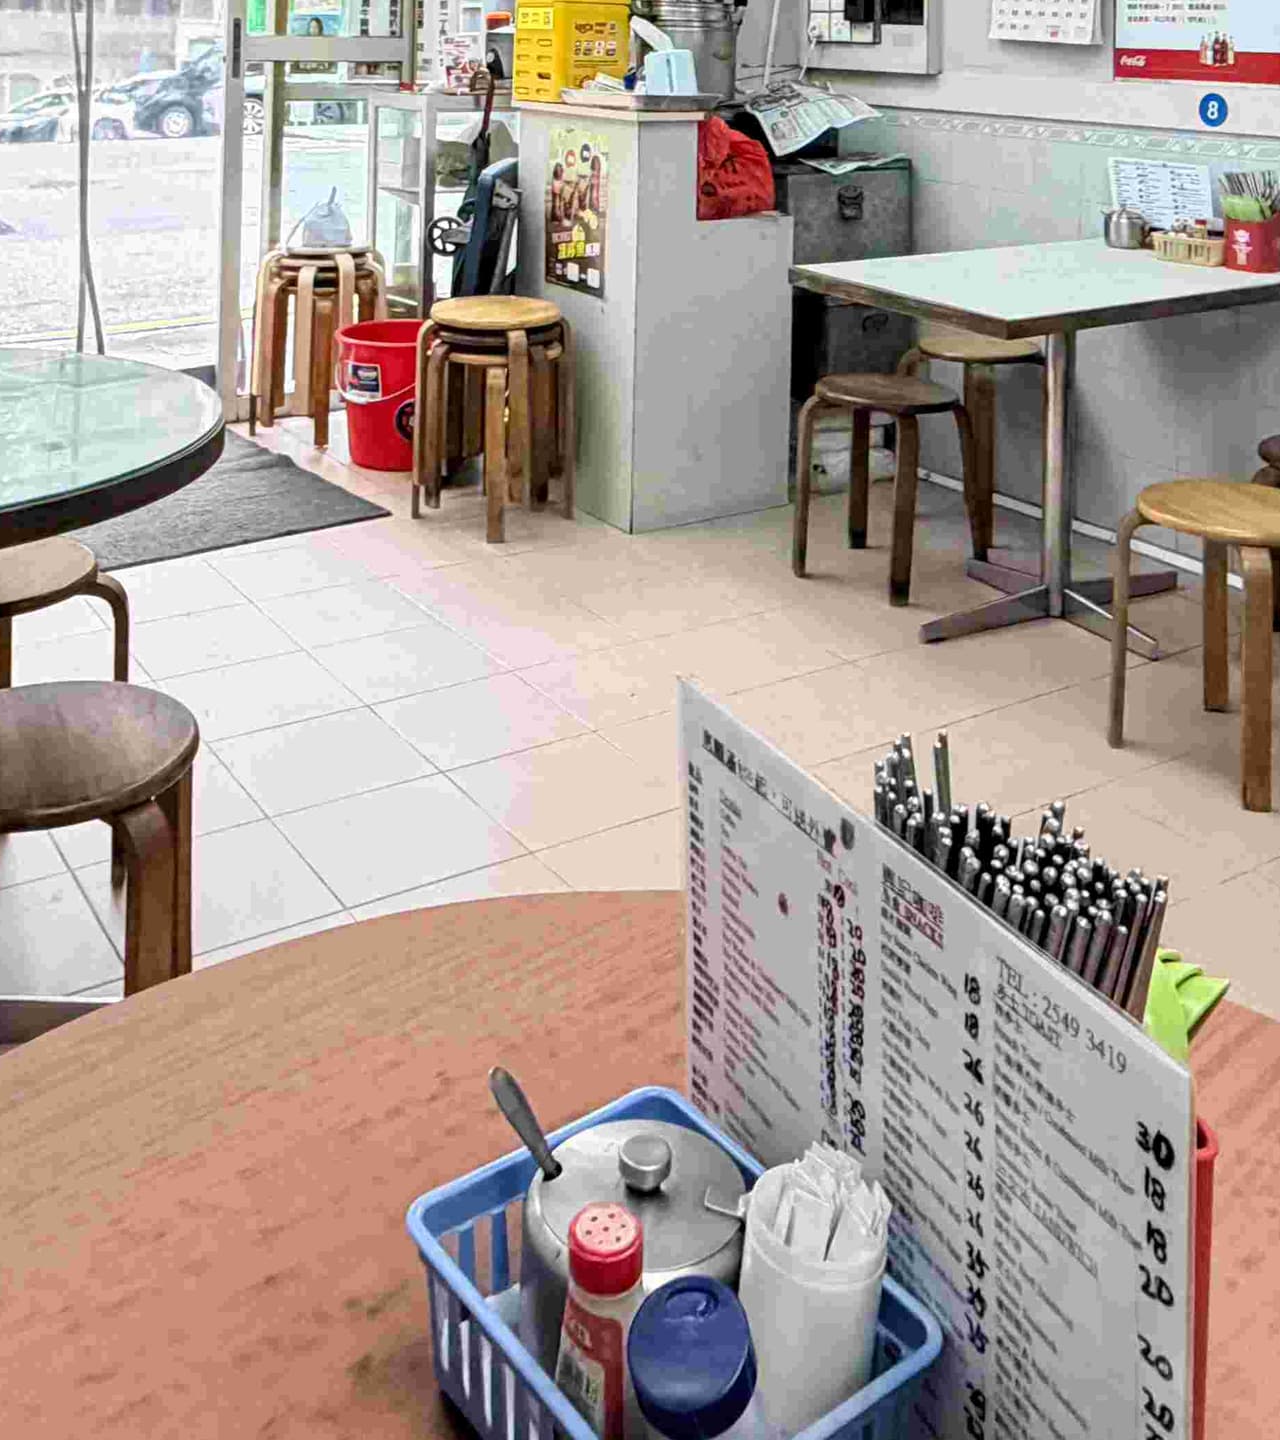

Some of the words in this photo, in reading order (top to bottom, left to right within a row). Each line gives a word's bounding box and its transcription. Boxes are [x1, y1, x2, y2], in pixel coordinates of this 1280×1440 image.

[1207, 100, 1219, 120] 8
[963, 971, 982, 1007] 18
[1042, 994, 1080, 1039] 2549
[1085, 1029, 1127, 1075] 3419
[963, 1092, 985, 1127] 26
[1136, 1120, 1175, 1172] 30
[966, 1169, 985, 1203] 26
[1143, 1166, 1167, 1212] 18
[1146, 1220, 1168, 1263] 18
[1137, 1265, 1175, 1309] 20
[1136, 1333, 1173, 1383] 20
